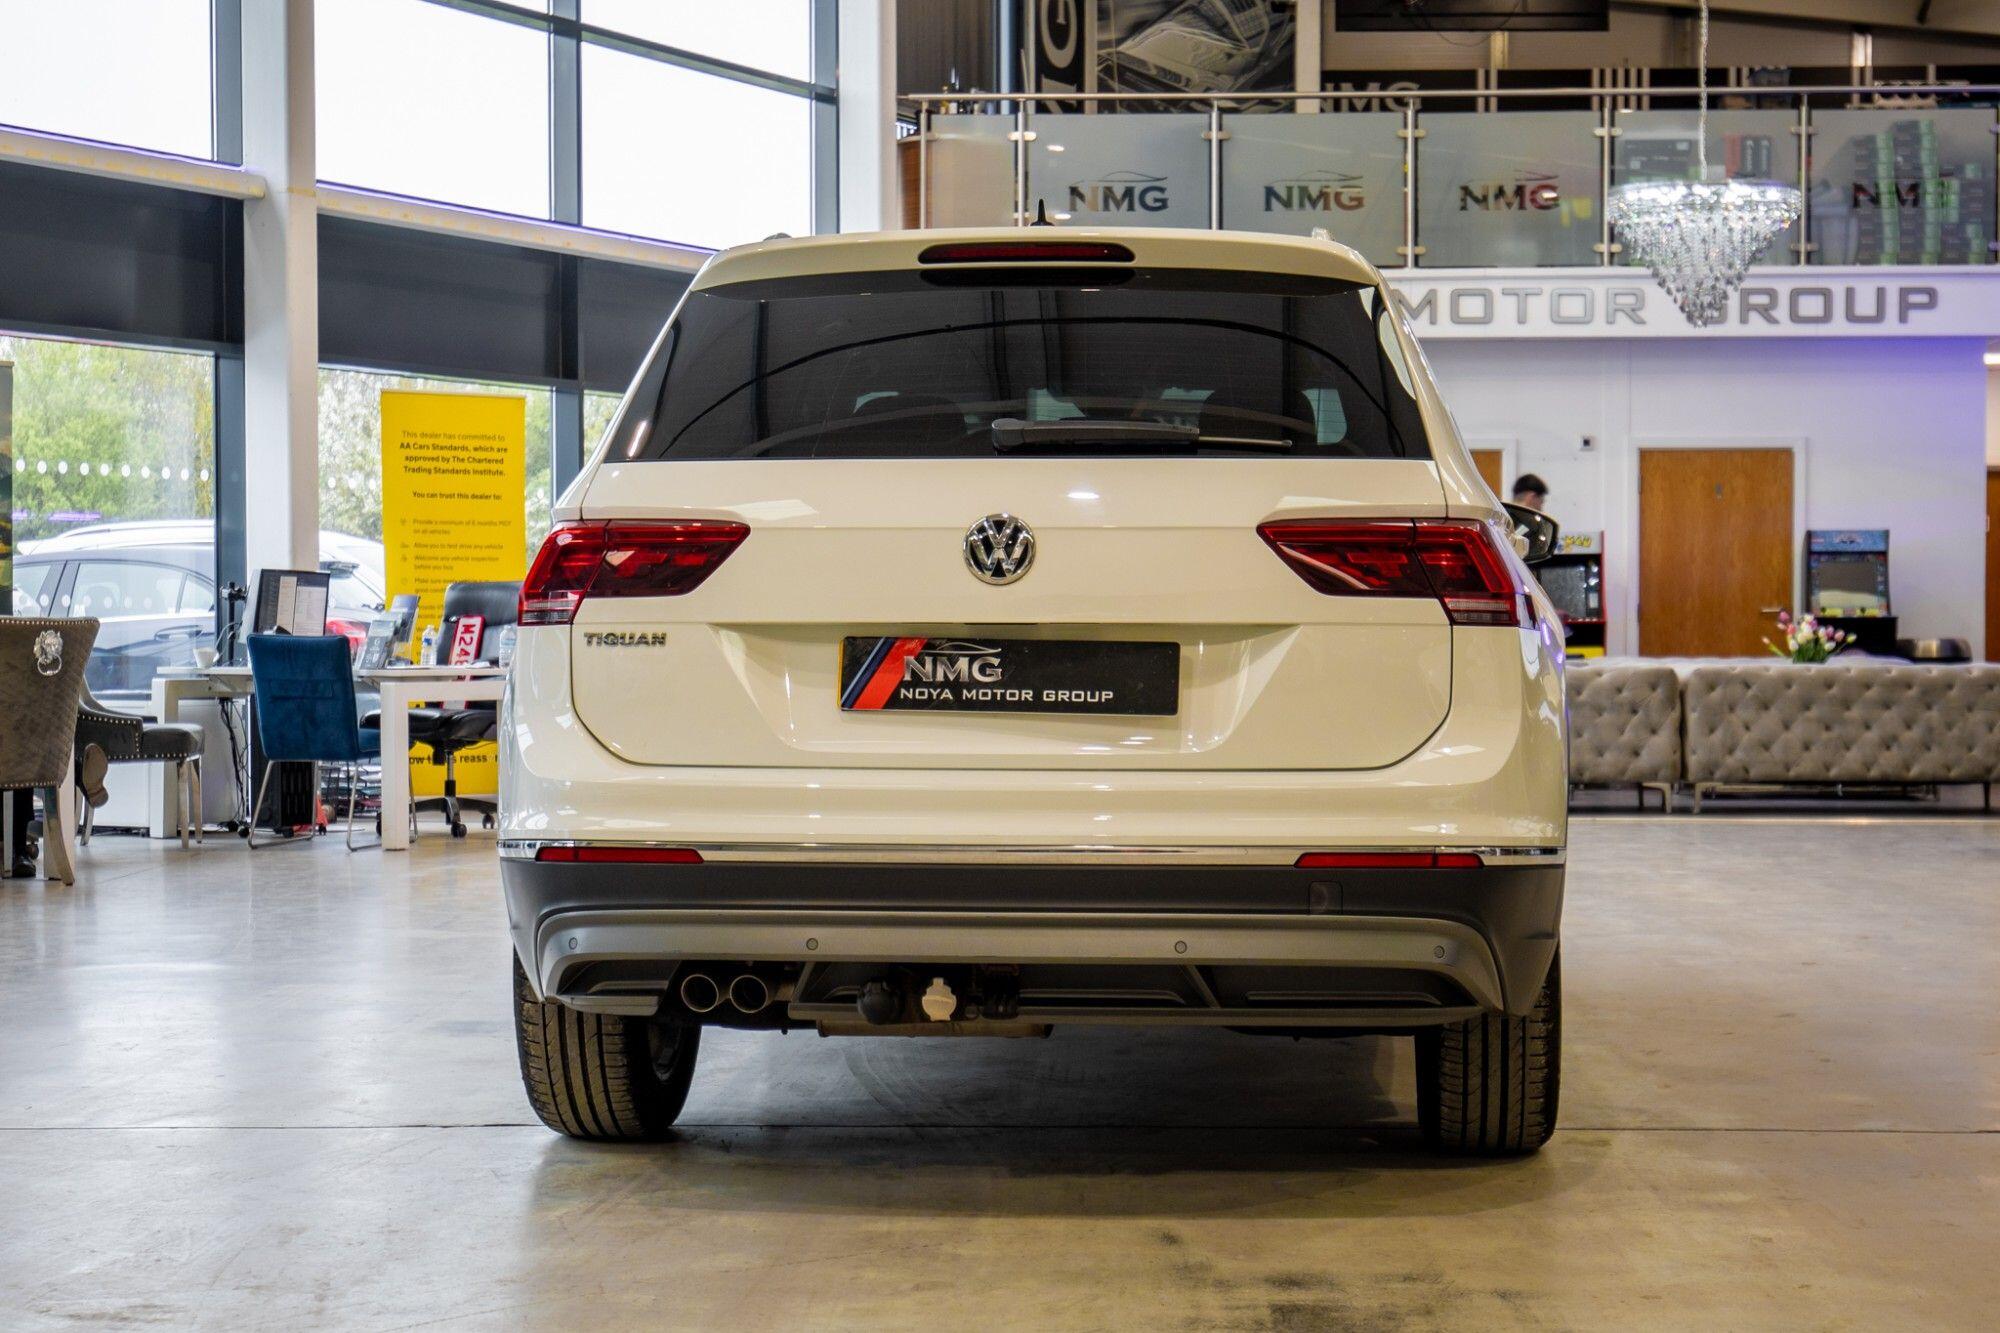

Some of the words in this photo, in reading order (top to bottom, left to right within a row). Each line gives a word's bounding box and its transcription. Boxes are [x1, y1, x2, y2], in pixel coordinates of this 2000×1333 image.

[1068, 185, 1169, 212] NMG
[1263, 185, 1365, 212] NMG
[1459, 184, 1560, 211] NMG
[1390, 287, 1647, 325] MOTOR
[402, 430, 418, 438] This
[419, 431, 441, 439] dealer
[443, 432, 456, 440] has
[457, 433, 496, 441] committed
[412, 442, 430, 450] Cars
[431, 443, 471, 452] Standards,
[473, 445, 494, 453] which
[404, 455, 439, 464] approved
[441, 456, 450, 464] by
[467, 456, 504, 464] Chartered
[403, 466, 432, 475] Trading
[433, 466, 471, 475] Standards
[412, 490, 425, 498] You
[583, 632, 667, 647] TIGUAN
[903, 655, 1003, 683] NMG
[900, 687, 953, 700] NOYA
[963, 688, 1034, 701] MOTOR
[1043, 689, 1114, 703] GROUP
